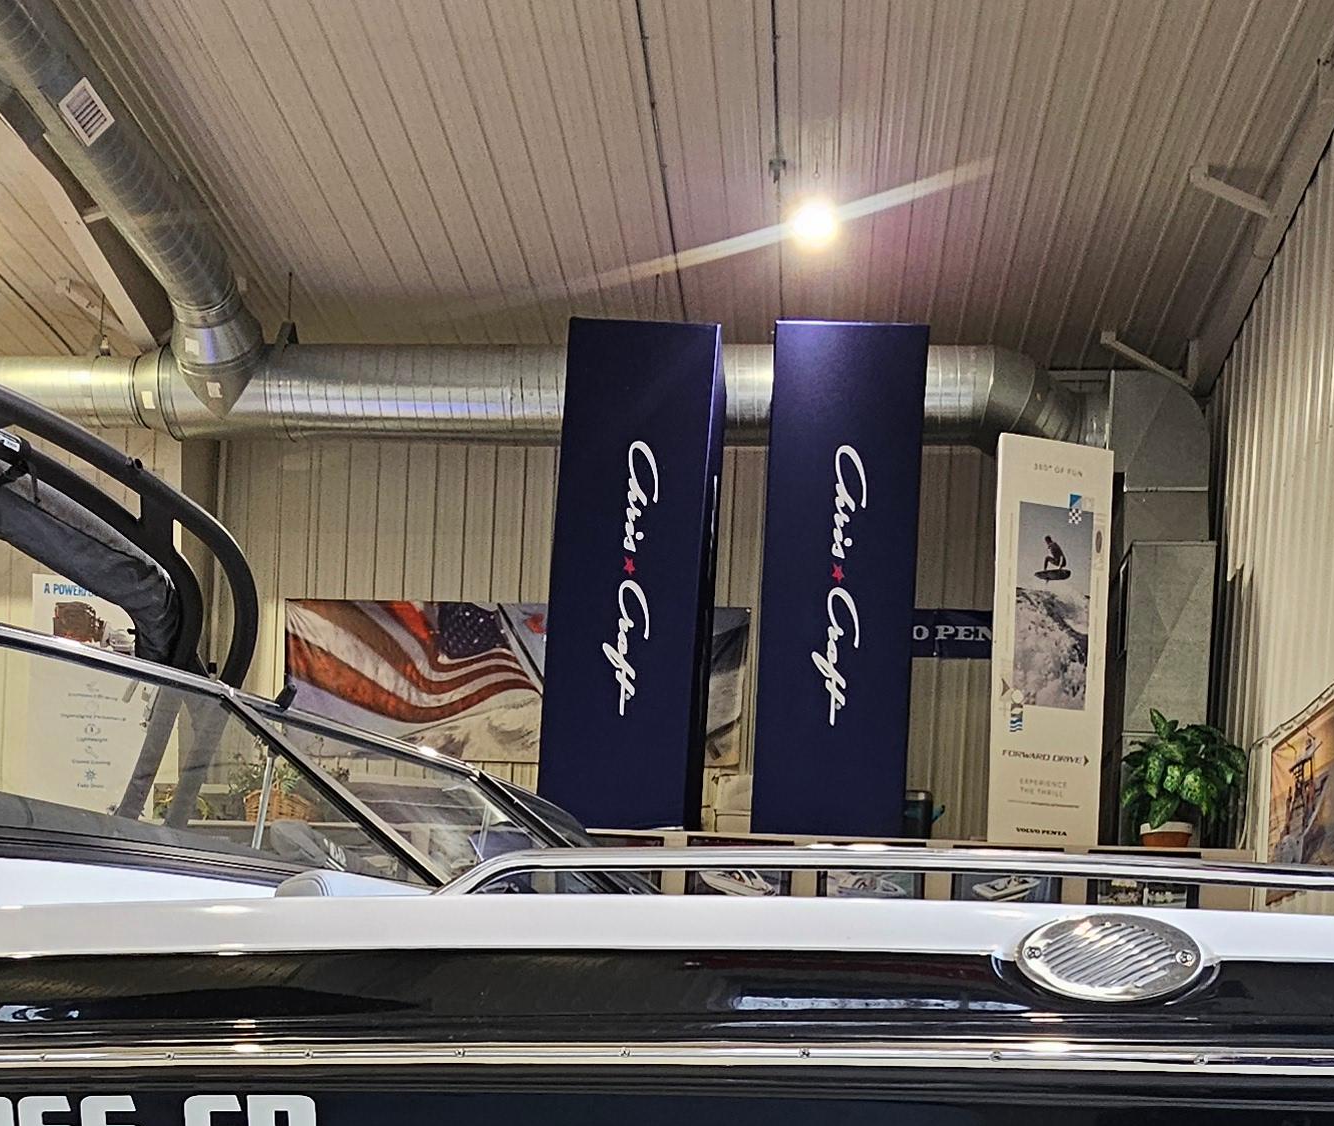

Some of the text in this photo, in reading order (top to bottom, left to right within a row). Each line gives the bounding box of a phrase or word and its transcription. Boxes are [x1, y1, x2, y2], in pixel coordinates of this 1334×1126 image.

[602, 440, 658, 716] Chris Craft
[811, 444, 867, 726] Chris Craft
[1002, 749, 1082, 764] FORWARD DRIVE
[1015, 826, 1068, 837] VOLVO PENTA
